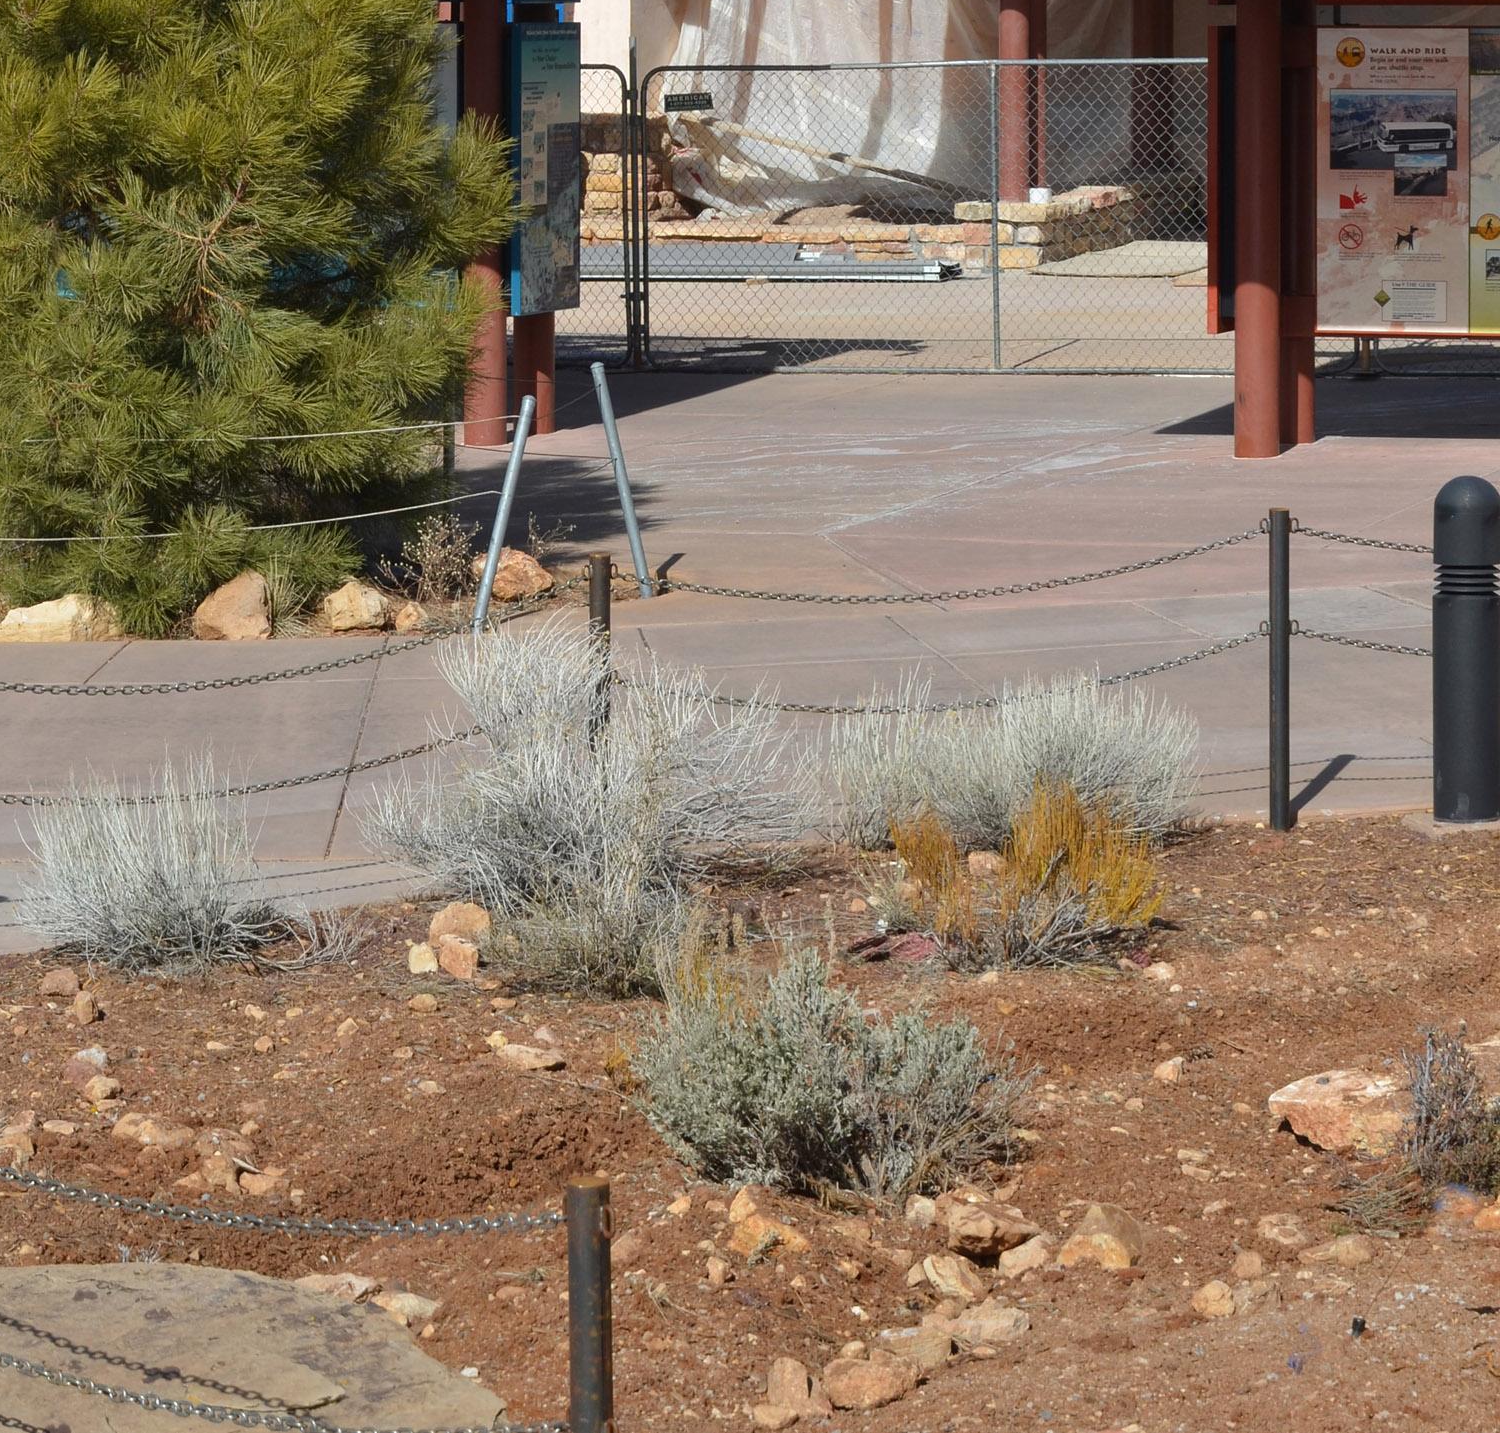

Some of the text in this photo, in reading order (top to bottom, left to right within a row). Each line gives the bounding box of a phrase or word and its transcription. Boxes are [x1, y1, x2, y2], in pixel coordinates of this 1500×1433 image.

[1370, 47, 1447, 55] WALK AND RIDE
[667, 93, 710, 103] AMERICAN
